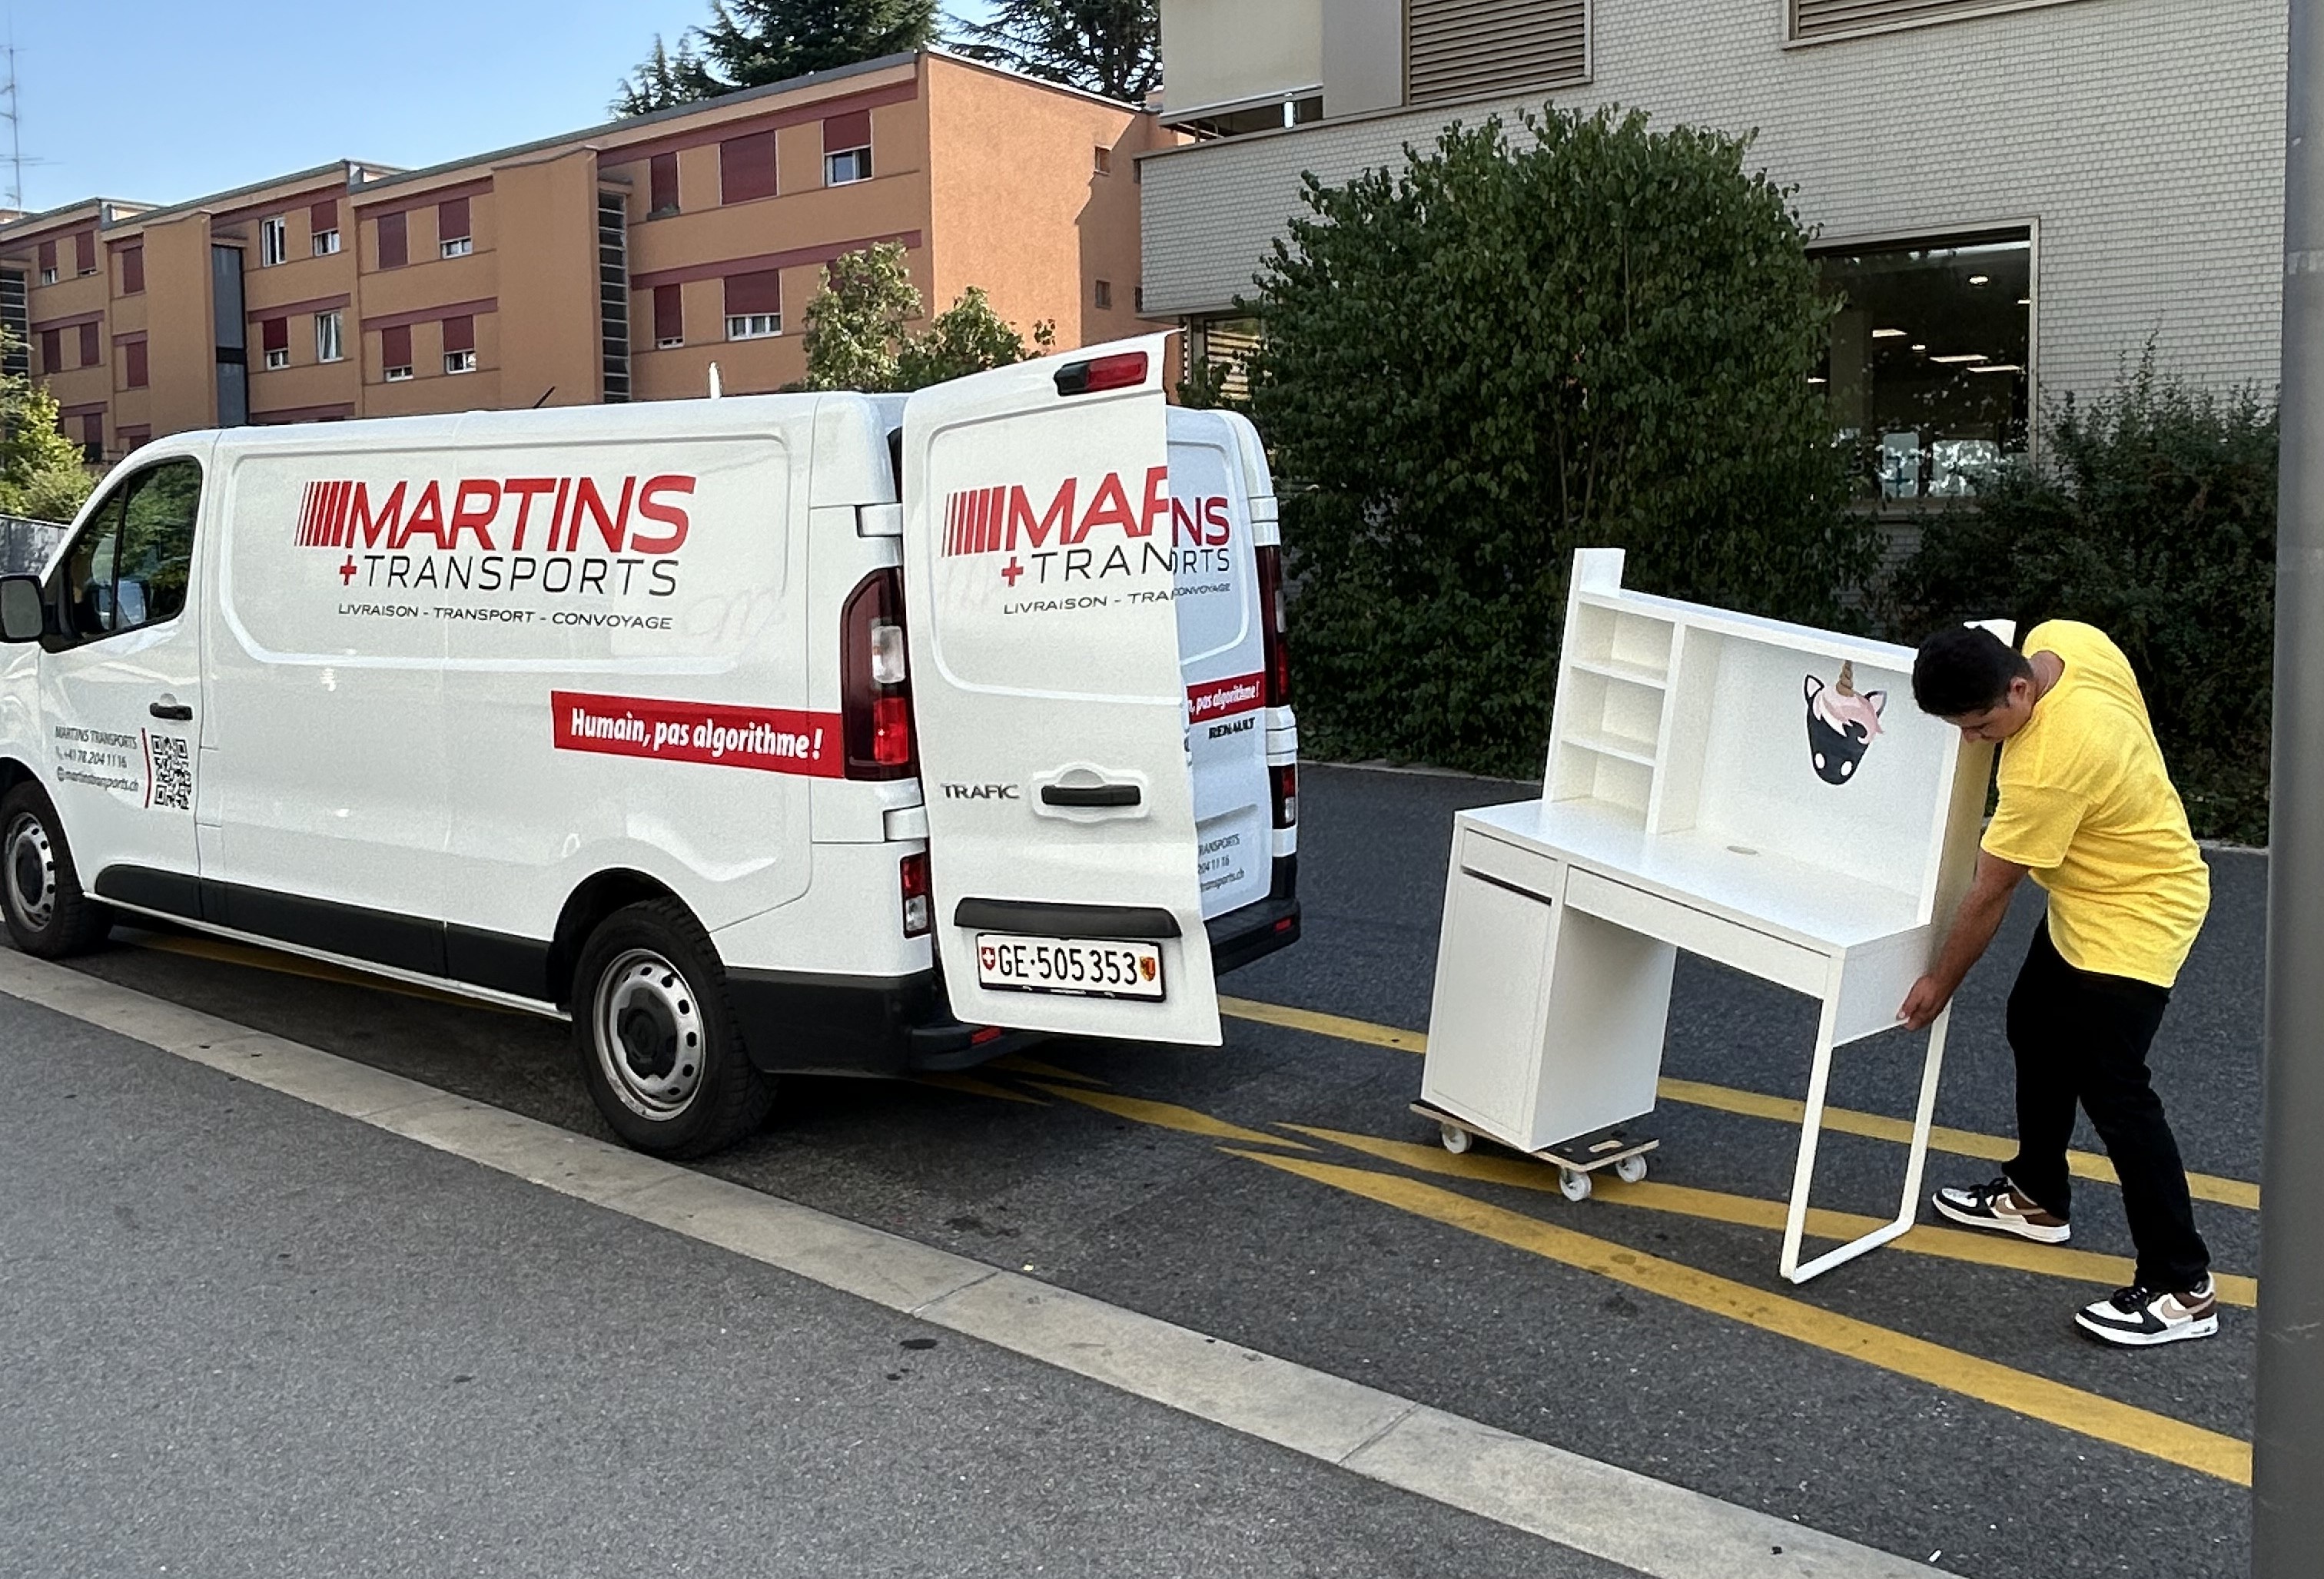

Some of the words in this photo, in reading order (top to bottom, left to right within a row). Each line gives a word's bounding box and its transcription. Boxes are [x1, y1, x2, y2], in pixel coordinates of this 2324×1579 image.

[344, 475, 697, 554] MARTINS
[338, 603, 419, 618] LIVRAISON
[433, 607, 536, 623] TRANSPORT
[552, 612, 672, 630] CONVOYAGE
[1004, 595, 1108, 615] LIVRAISON
[571, 708, 651, 747] Humain,
[653, 721, 689, 751] pas
[1208, 717, 1256, 739] RENAULT
[940, 783, 1020, 799] TRAFIC
